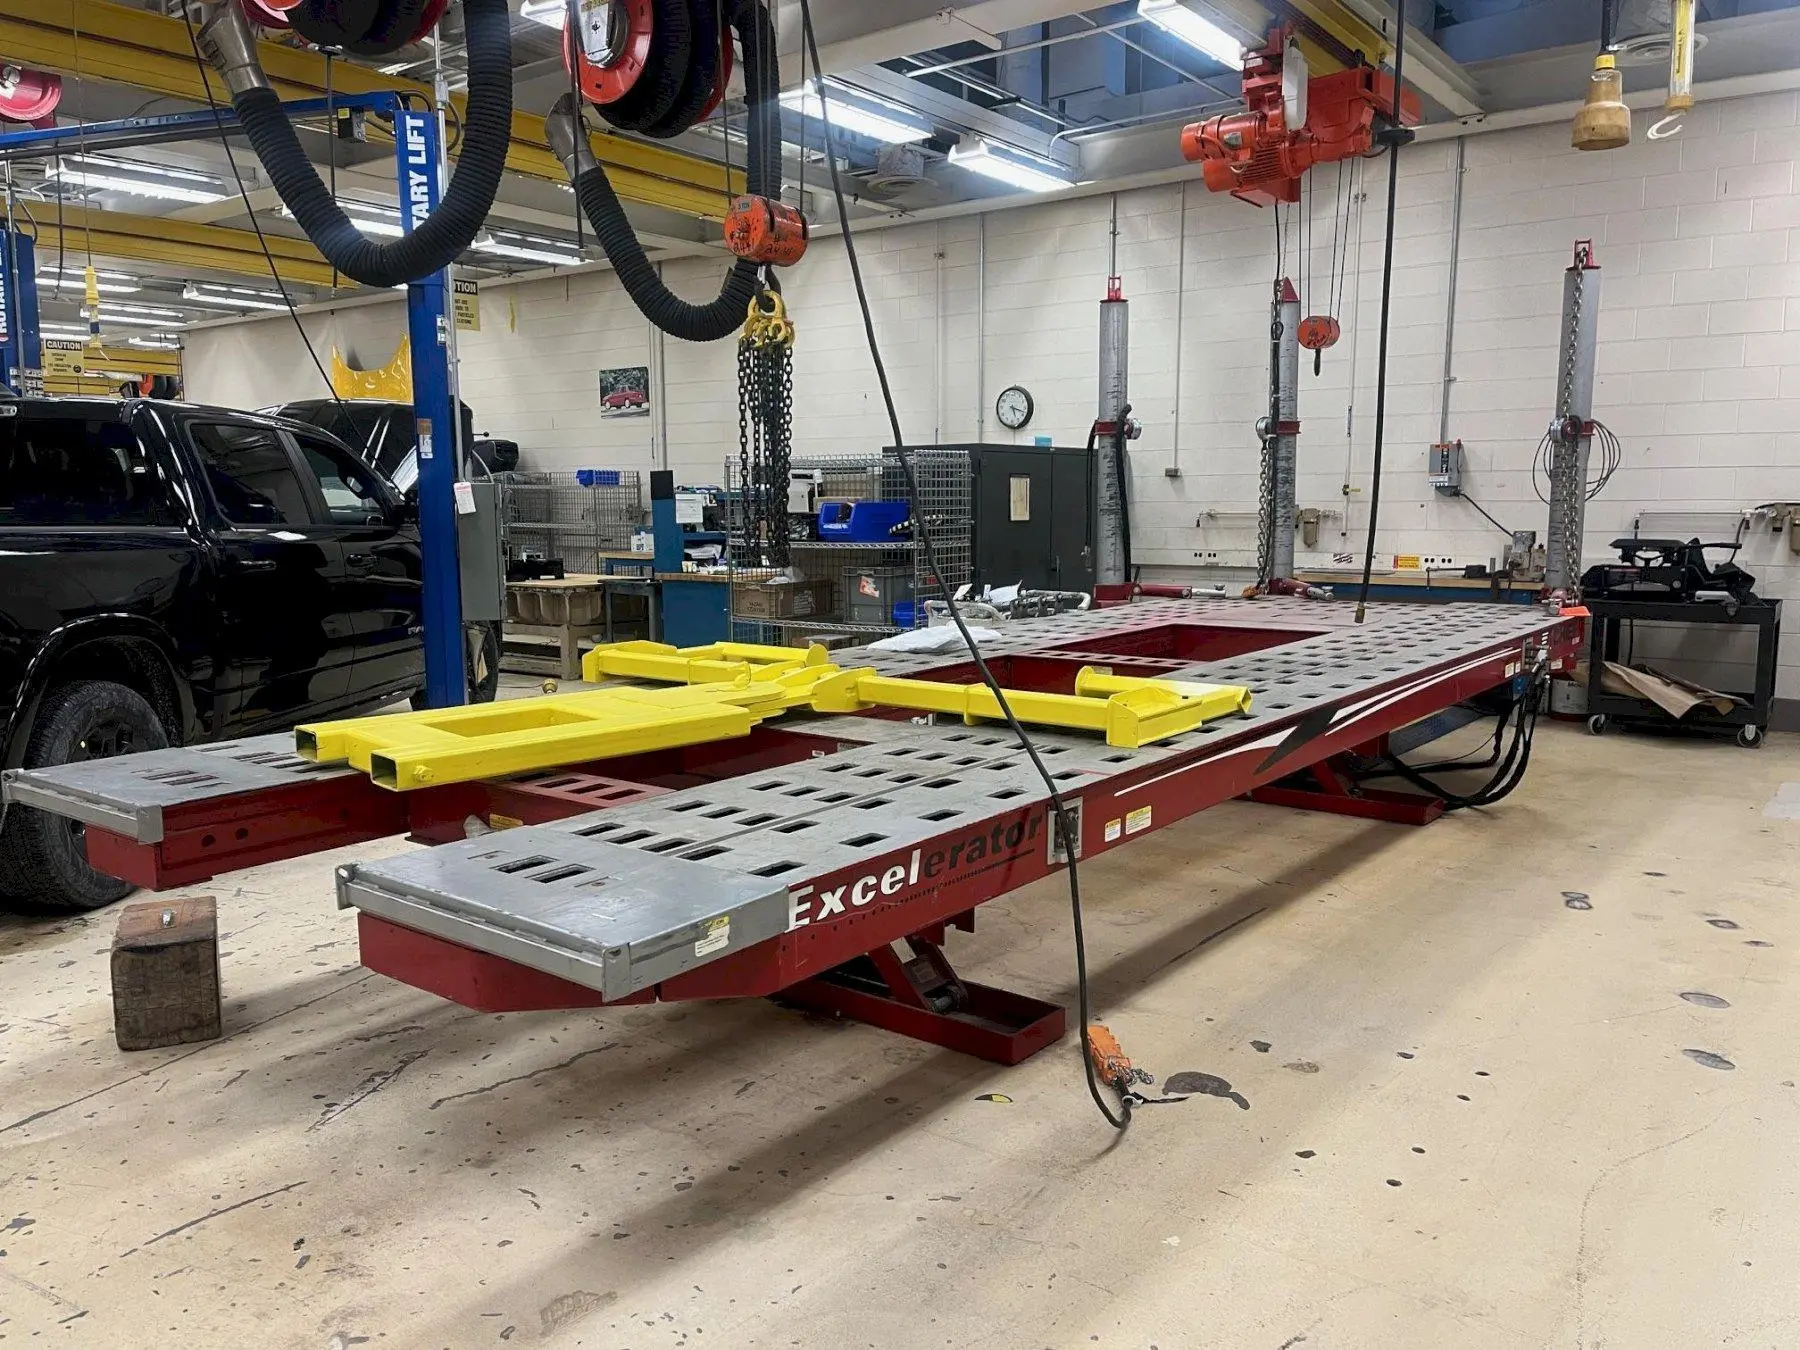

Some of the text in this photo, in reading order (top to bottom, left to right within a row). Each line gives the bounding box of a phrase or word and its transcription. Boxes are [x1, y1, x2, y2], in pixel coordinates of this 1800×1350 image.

[405, 115, 430, 231] TARY LIFT
[456, 281, 477, 293] TION
[46, 340, 81, 350] CAUTION
[785, 815, 1044, 933] Excelerator
